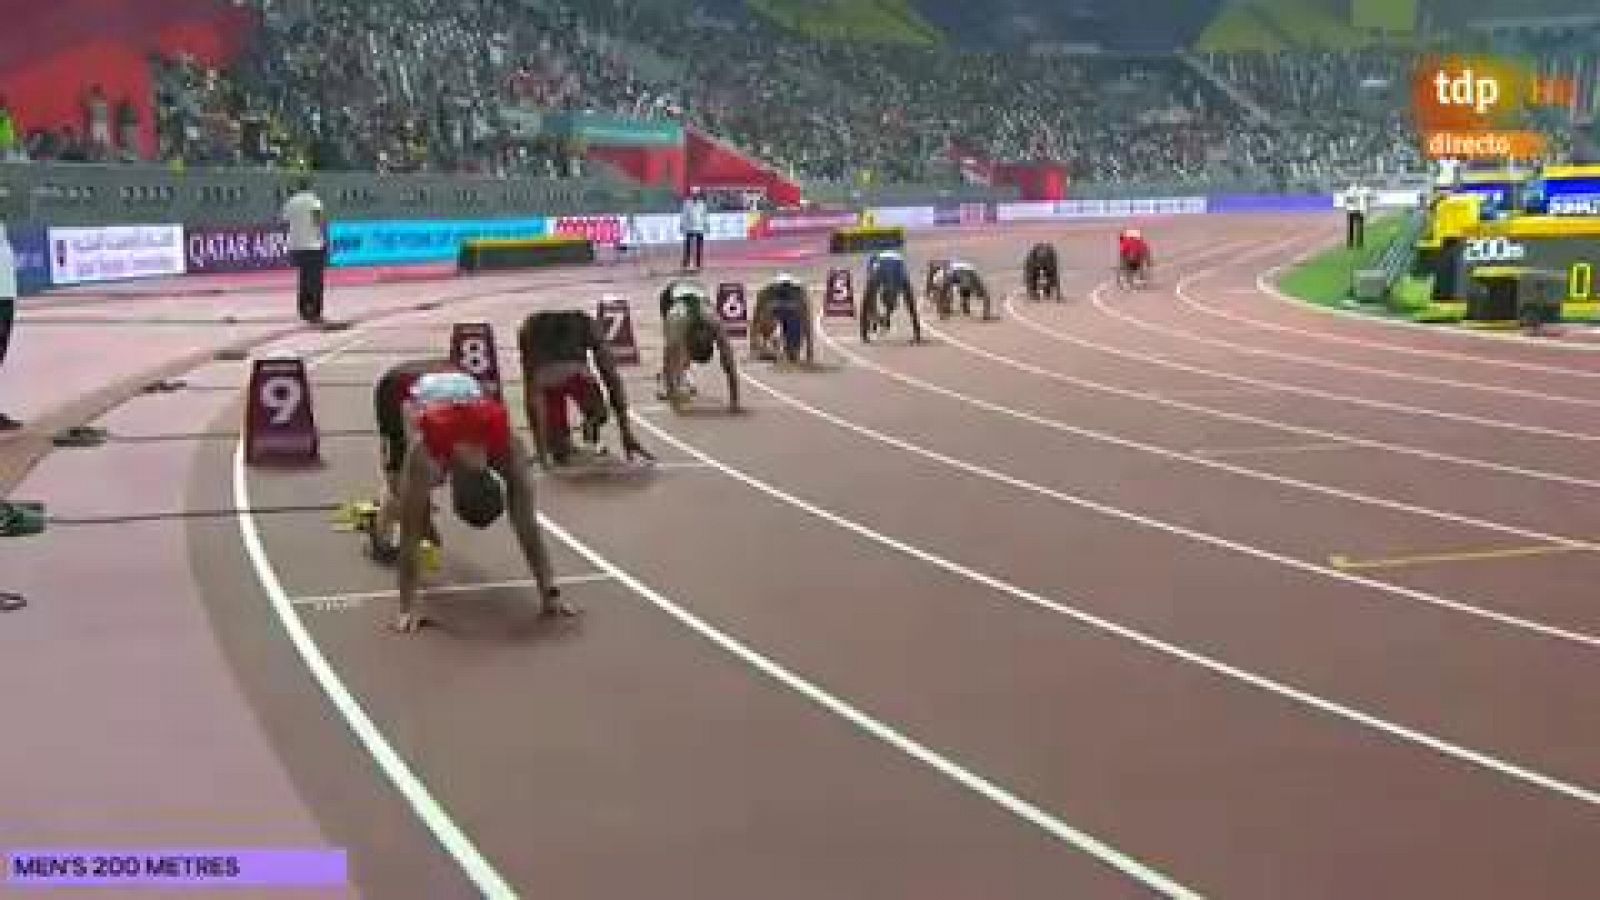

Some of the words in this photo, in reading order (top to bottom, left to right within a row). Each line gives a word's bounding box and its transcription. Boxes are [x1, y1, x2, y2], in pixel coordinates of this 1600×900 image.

[190, 231, 247, 267] QATAR
[830, 279, 848, 304] 5
[1571, 263, 1592, 298] 0
[722, 294, 745, 317] 6
[603, 311, 624, 342] 7
[460, 336, 491, 371] 8
[261, 378, 299, 424] 9
